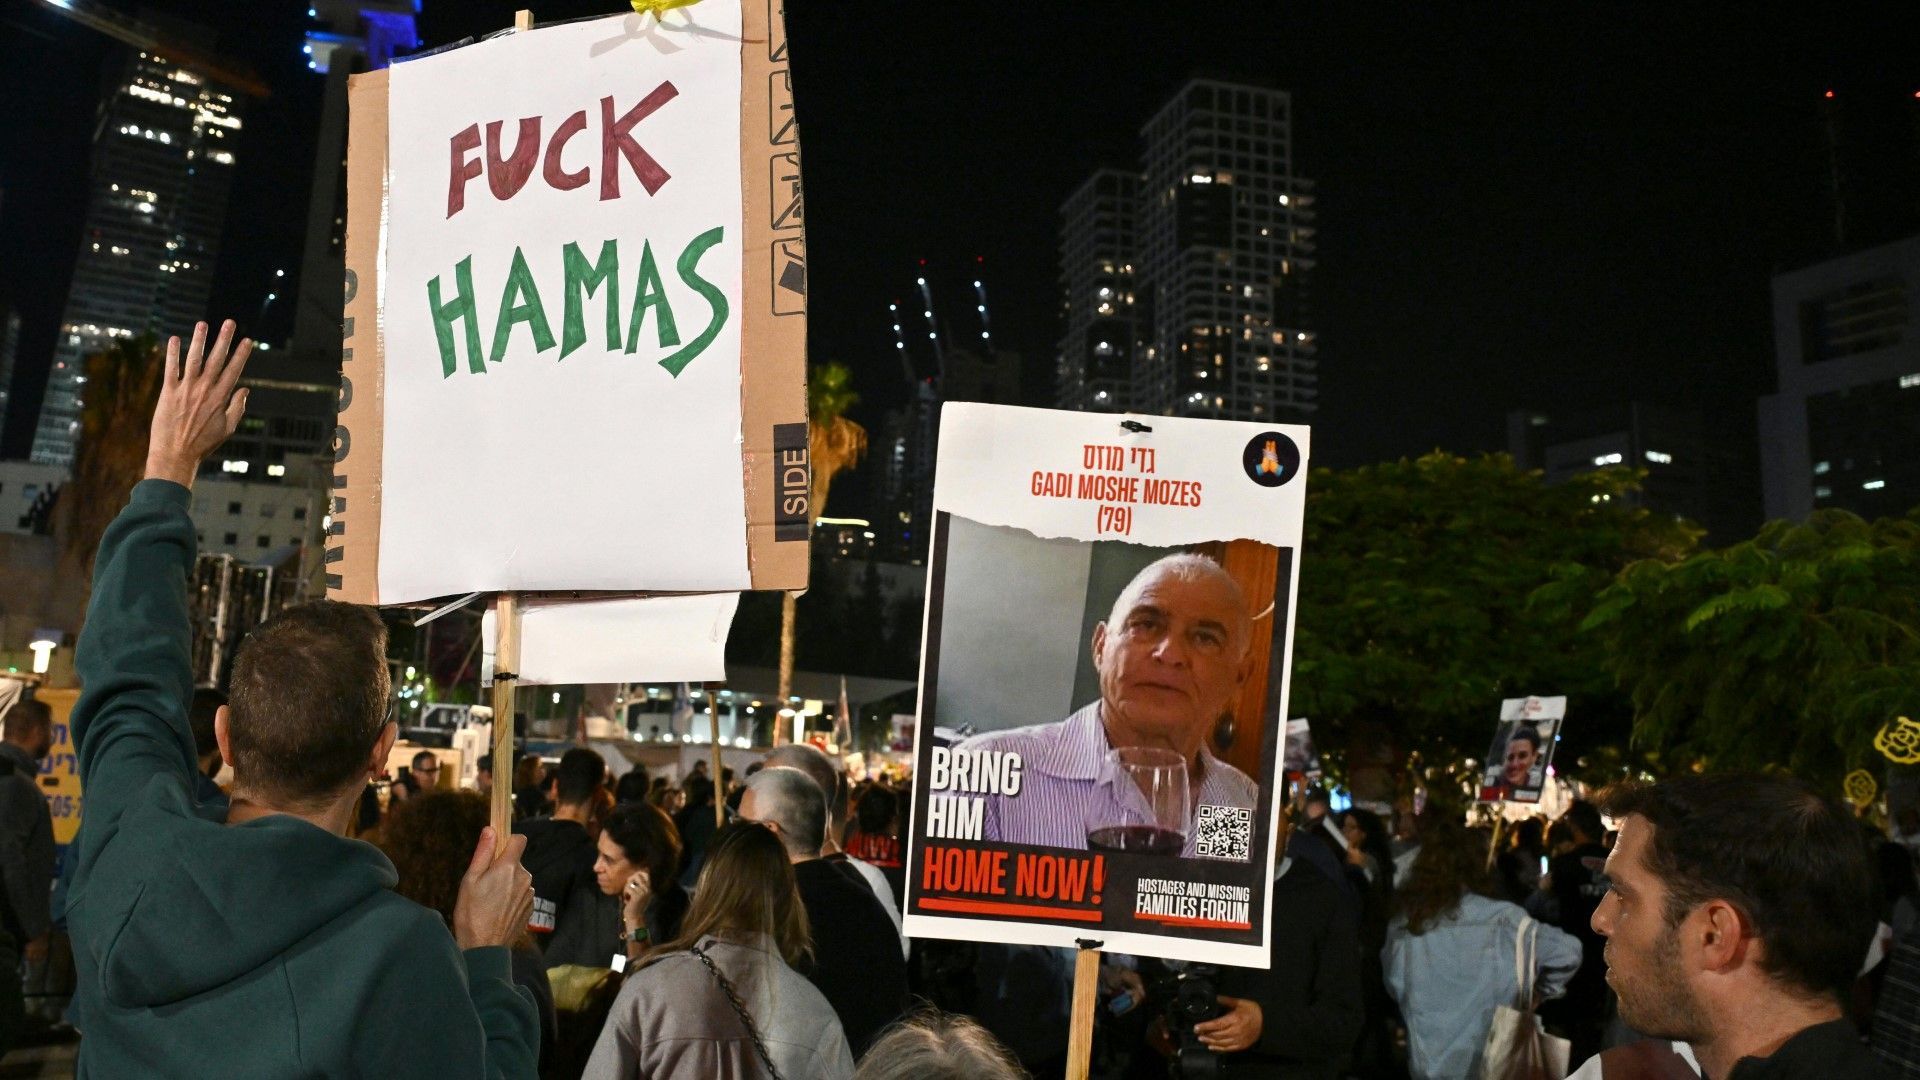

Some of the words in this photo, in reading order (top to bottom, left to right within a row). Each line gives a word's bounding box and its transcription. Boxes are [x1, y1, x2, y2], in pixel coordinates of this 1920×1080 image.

[446, 80, 679, 219] FUCK
[427, 226, 729, 378] HAMAS
[1083, 444, 1124, 472] מוזס
[1130, 447, 1156, 474] גדי
[783, 448, 808, 516] SIDE
[1031, 471, 1072, 498] GADI
[1077, 474, 1138, 503] MOSHE
[1143, 479, 1202, 507] MOZES
[1097, 504, 1132, 536] (79)
[929, 745, 1022, 796] BRING
[926, 794, 984, 841] HIM
[923, 846, 1008, 895] HOME
[1015, 853, 1104, 905] NOW!
[1137, 878, 1186, 896] HOSTAGES
[1186, 882, 1206, 898] AND
[1207, 883, 1250, 902] MISSING
[1135, 893, 1197, 919] FAMILIES
[1199, 898, 1250, 924] FORUM
